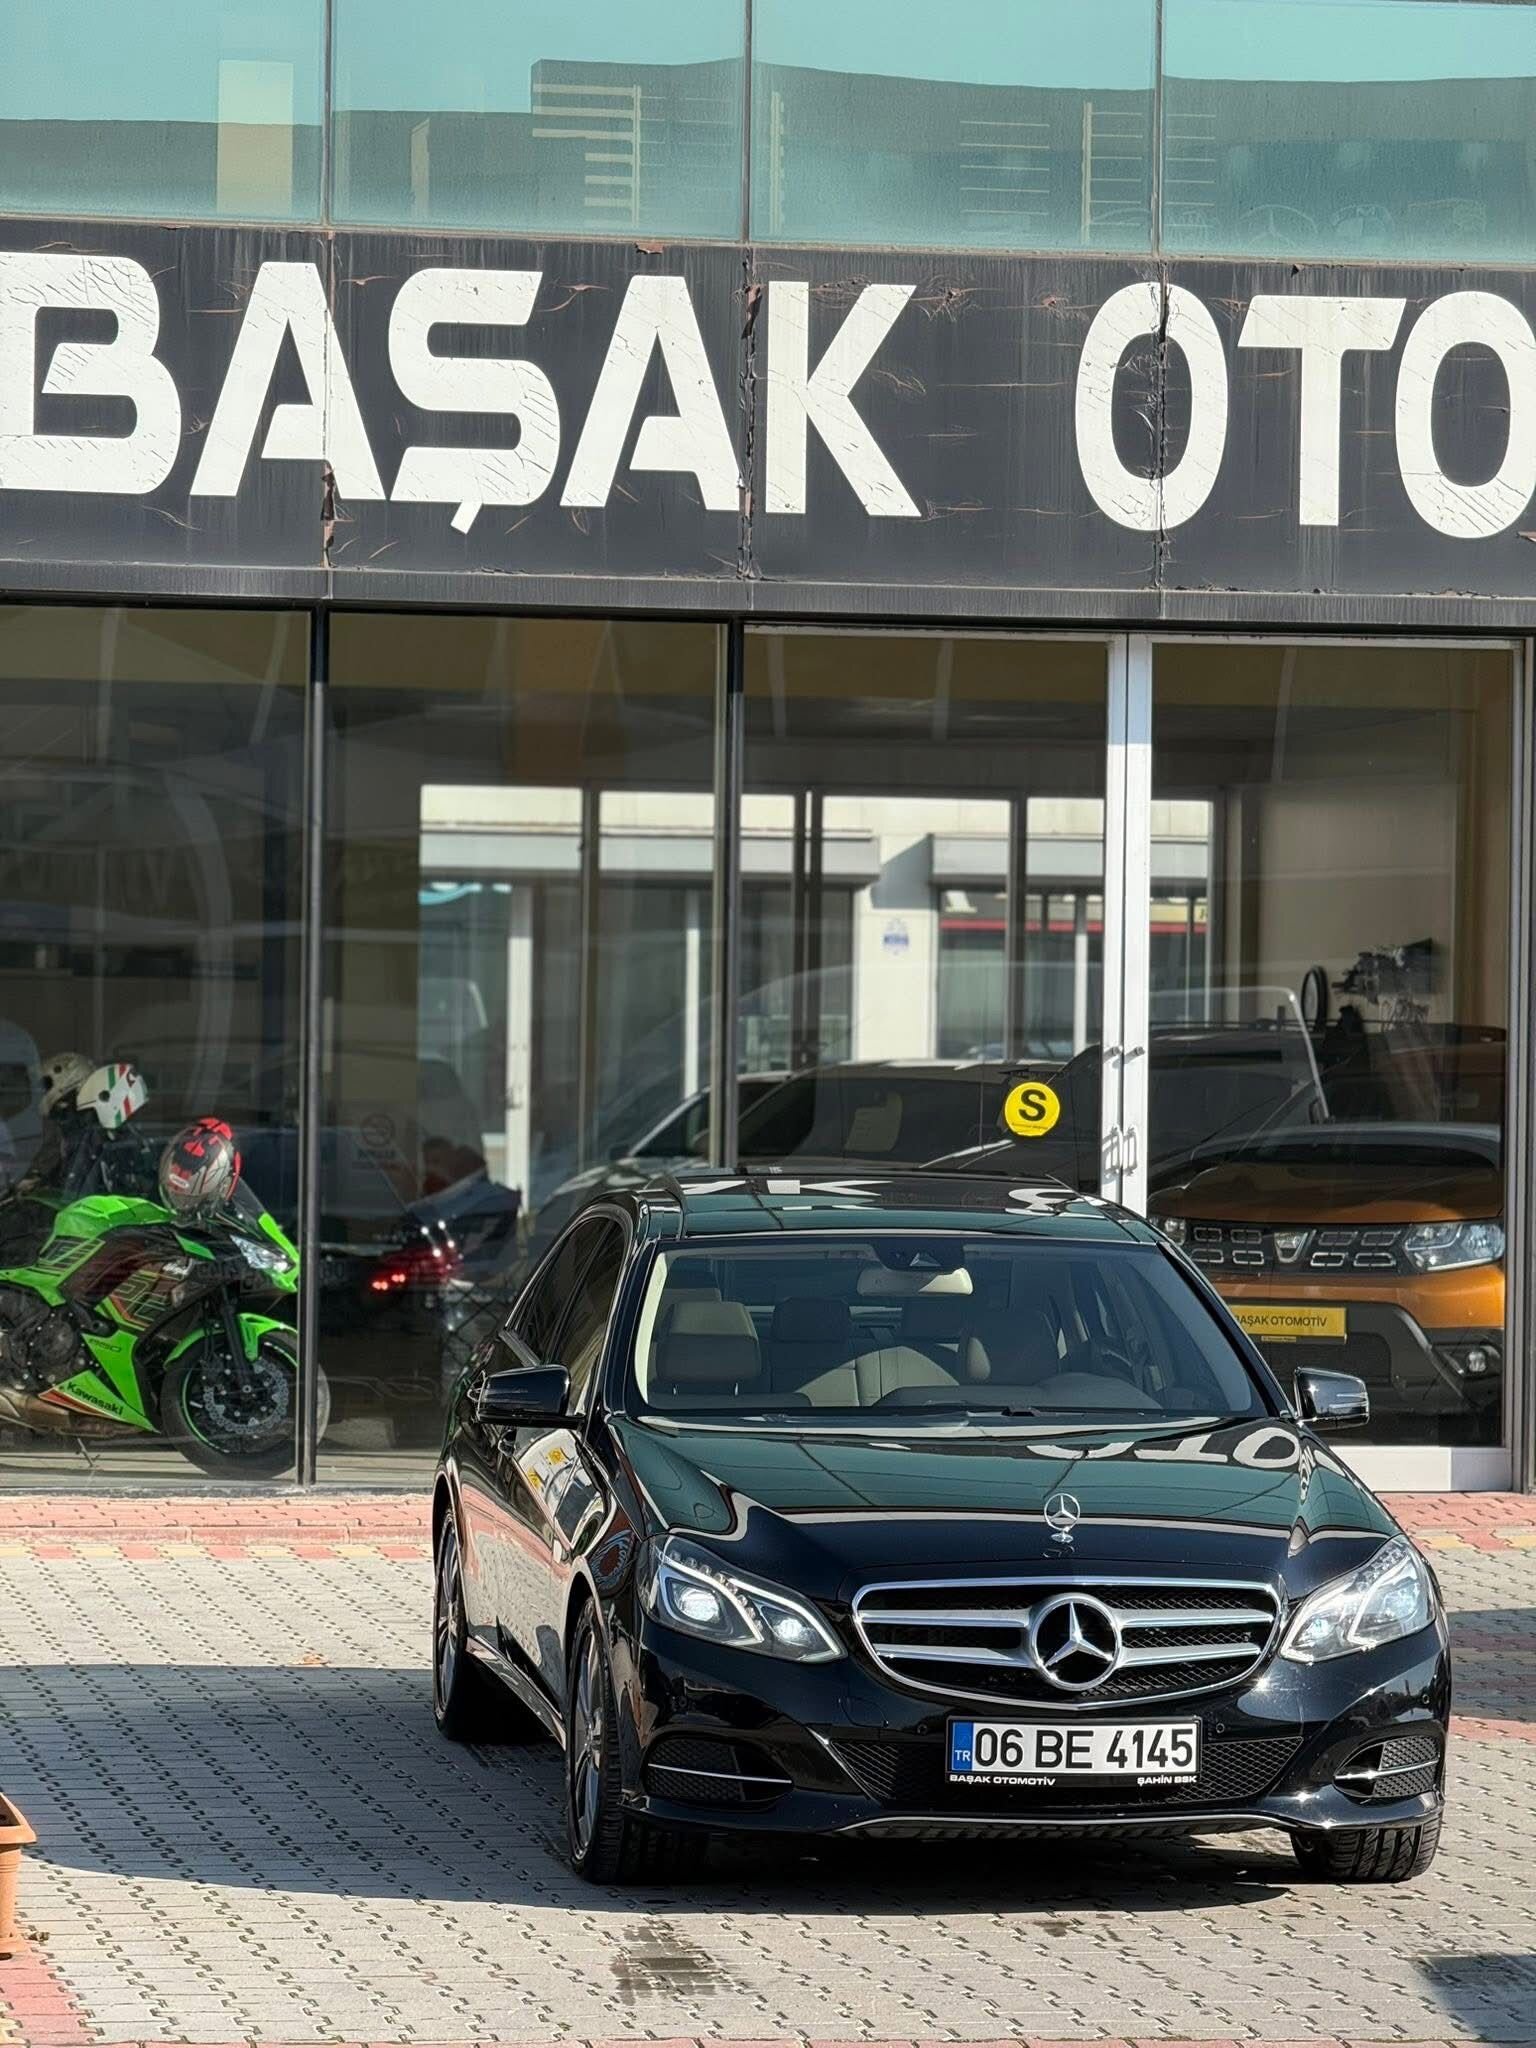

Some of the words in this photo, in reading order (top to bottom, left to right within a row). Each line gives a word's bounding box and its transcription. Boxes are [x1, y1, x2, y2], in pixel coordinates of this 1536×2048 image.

[0, 251, 921, 535] BAŞAK
[1074, 281, 1536, 539] OTO
[1018, 1089, 1047, 1122] S
[1270, 1315, 1328, 1327] OTOMOTİV
[66, 1381, 124, 1416] Kawasaki
[954, 1749, 971, 1762] TR
[975, 1727, 1024, 1768] 06
[1035, 1729, 1095, 1769] BE
[1106, 1728, 1193, 1769] 4145
[949, 1773, 991, 1785] BAŞAK
[993, 1775, 1057, 1787] OTOMOTİV
[1137, 1774, 1173, 1787] ŞAHİN
[1174, 1775, 1198, 1784] BSK
